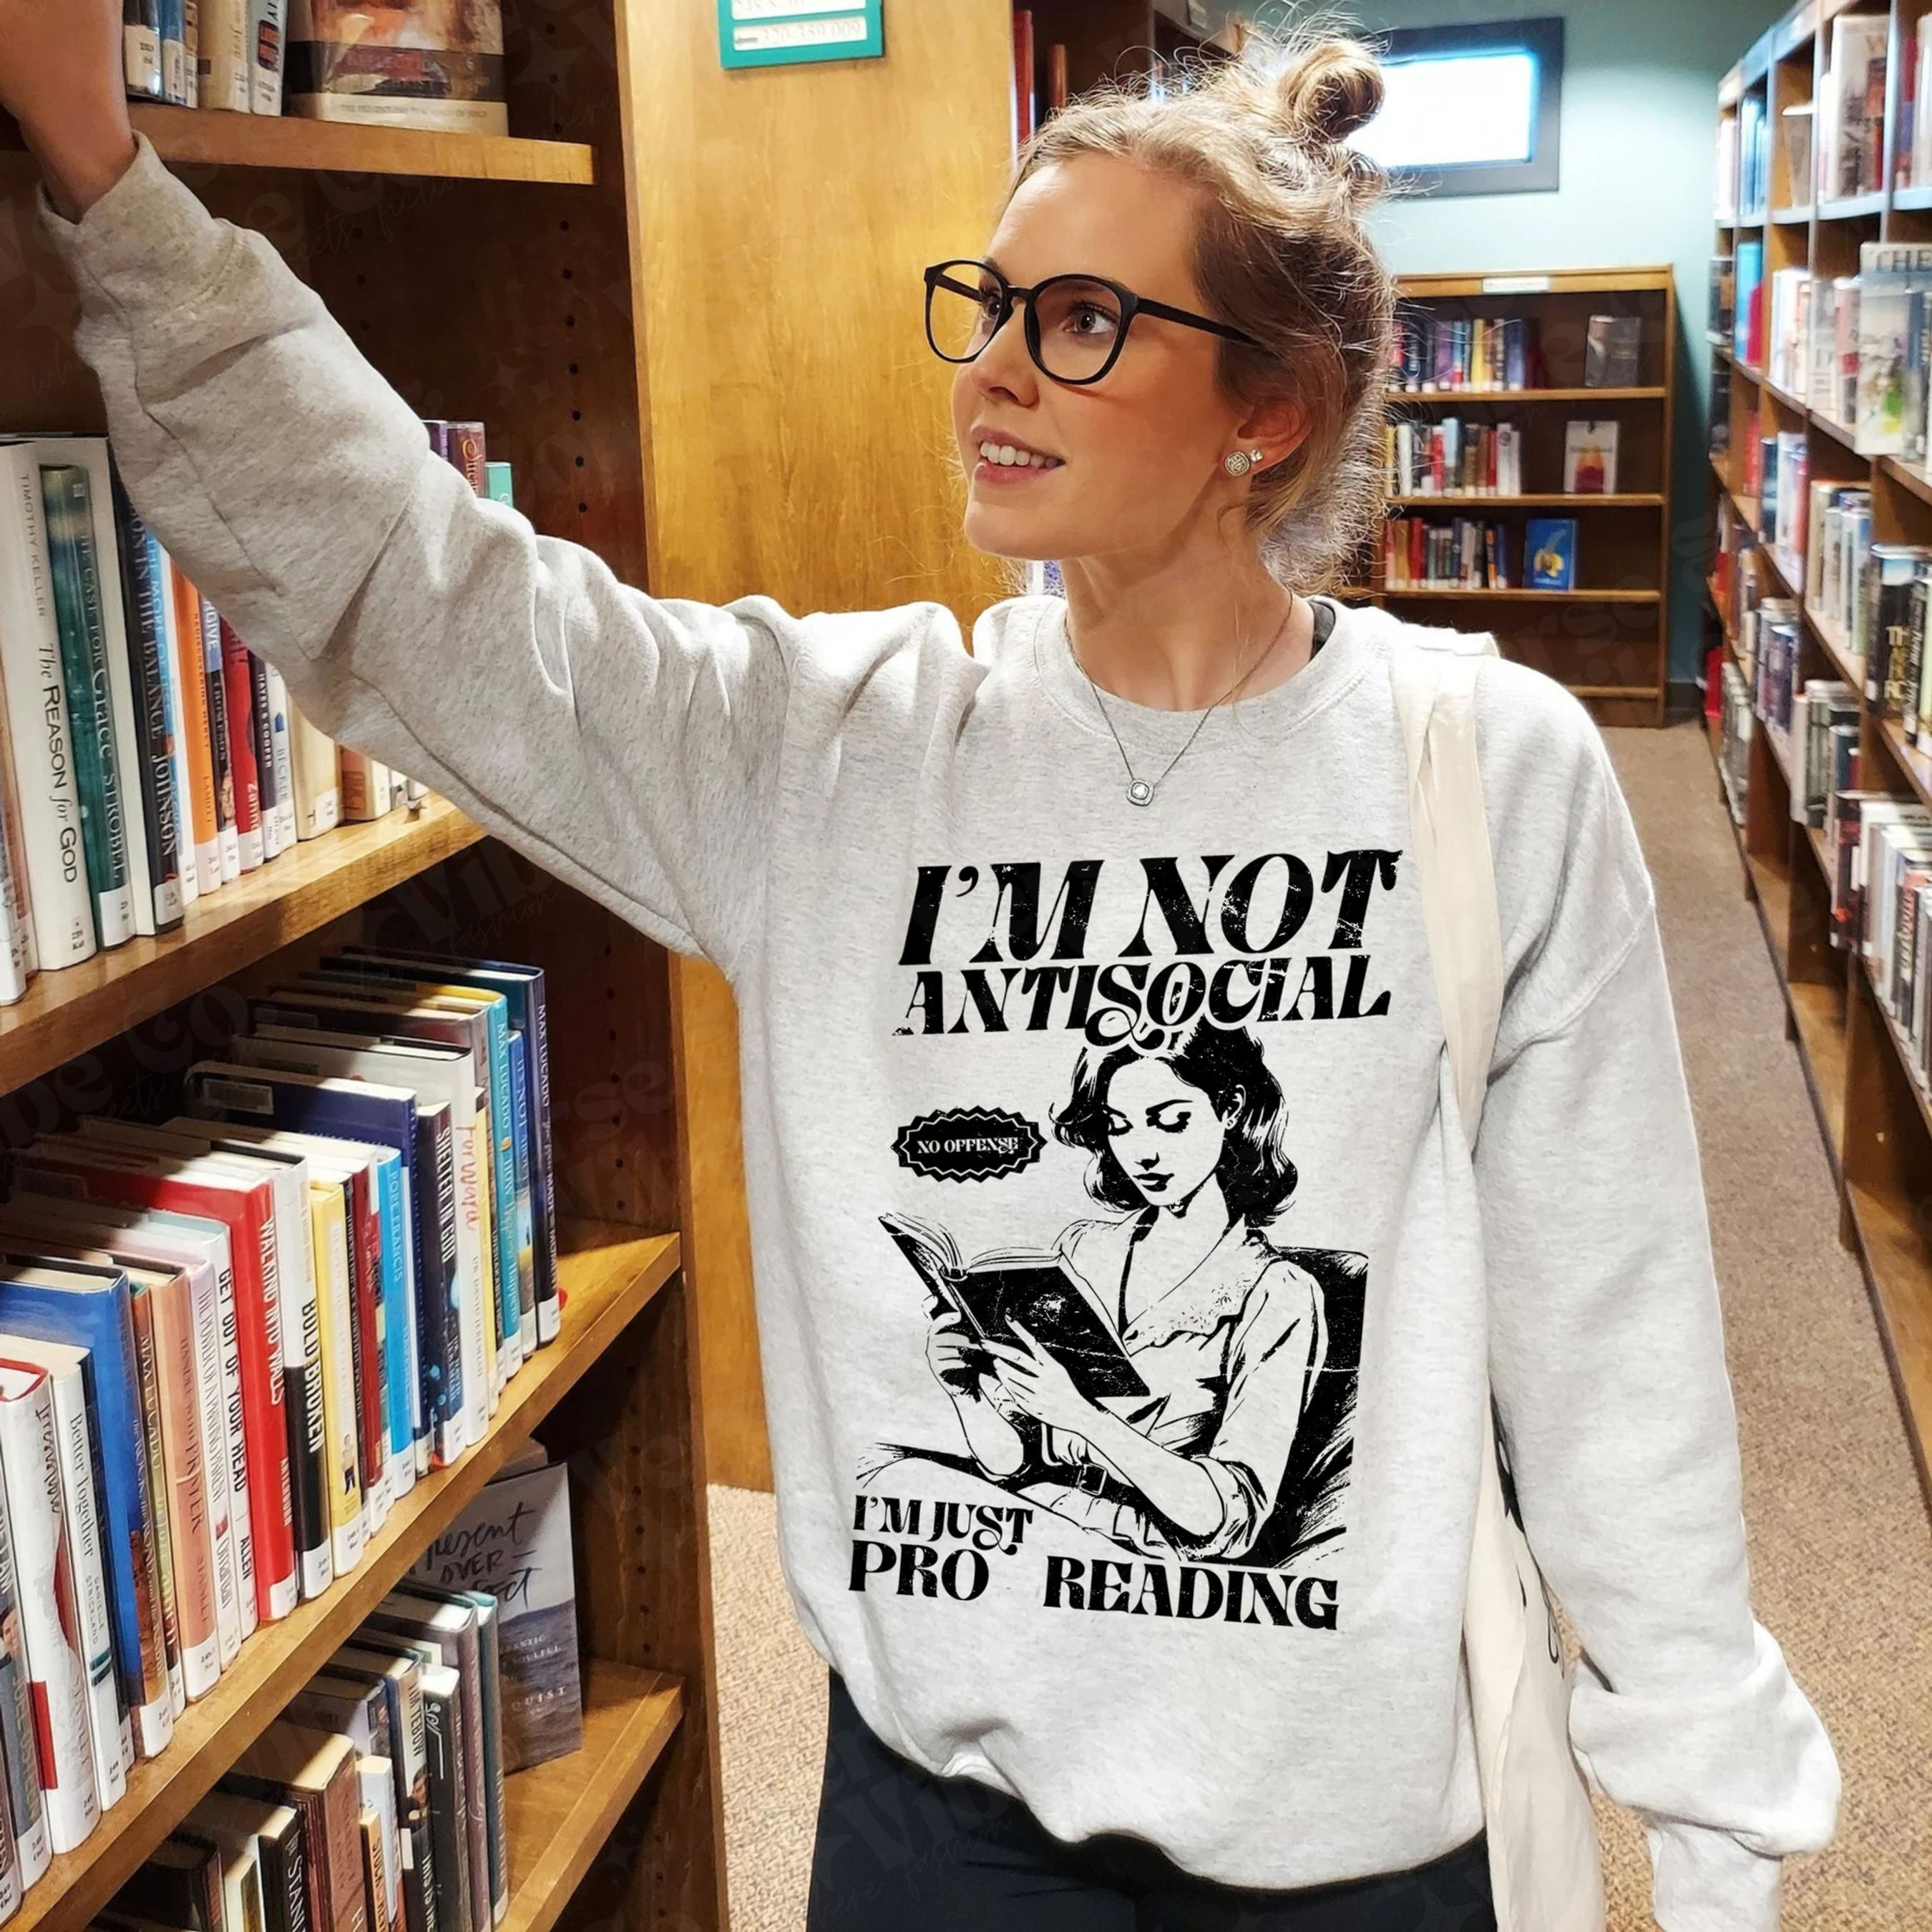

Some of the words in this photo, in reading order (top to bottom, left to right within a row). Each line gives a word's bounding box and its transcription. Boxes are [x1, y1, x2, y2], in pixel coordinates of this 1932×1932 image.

[19, 473, 39, 549] TIMOTHY
[30, 554, 46, 618] KELLER
[135, 556, 150, 581] IN
[138, 586, 156, 634] THE
[151, 580, 165, 630] MORE
[39, 643, 57, 678] The
[143, 640, 165, 740] BALANCE
[43, 684, 68, 789] REASON
[263, 723, 273, 769] COOPER
[276, 748, 289, 801] BECKER
[49, 795, 73, 819] for
[102, 773, 127, 880] STROBEL
[151, 753, 177, 857] JOHNSON
[59, 827, 78, 883] GOD
[1118, 849, 1403, 957] NOT
[538, 1005, 547, 1039] MAX
[892, 954, 1392, 1050] ANTISOCIAL
[499, 1064, 508, 1128] LUCADO
[540, 1044, 549, 1107] LUCADO
[517, 1087, 526, 1127] NOT
[437, 1126, 453, 1201] SHELTER
[917, 1140, 941, 1154] NO
[944, 1137, 1019, 1155] OFFENSE
[387, 1170, 401, 1214] POPE
[455, 1125, 479, 1231] Forward
[546, 1173, 555, 1211] MADE
[441, 1201, 452, 1224] IN
[259, 1216, 275, 1302] WALKING
[391, 1215, 404, 1283] FRANCIS
[441, 1226, 455, 1264] GOD
[218, 1267, 233, 1305] GET
[223, 1312, 236, 1347] OUT
[264, 1304, 279, 1344] INTO
[301, 1297, 318, 1357] BOLD
[140, 1335, 152, 1382] MAX
[225, 1355, 238, 1377] OF
[268, 1345, 284, 1405] WALLS
[142, 1384, 160, 1469] LUCADO
[227, 1385, 243, 1437] YOUR
[306, 1361, 324, 1453] BROKEN
[70, 1413, 87, 1472] Better
[180, 1337, 190, 1396] HANDLE
[185, 1440, 203, 1534] PRAYER
[230, 1439, 247, 1493] HEAD
[74, 1472, 94, 1558] Together
[927, 1502, 1034, 1556] JUST
[241, 1536, 253, 1581] ALLEN
[440, 1548, 504, 1585] OVER
[848, 1539, 990, 1601] PRO
[1042, 1555, 1340, 1631] READING
[84, 1575, 99, 1645] STRICKLAND
[410, 1709, 420, 1757] TEBOW
